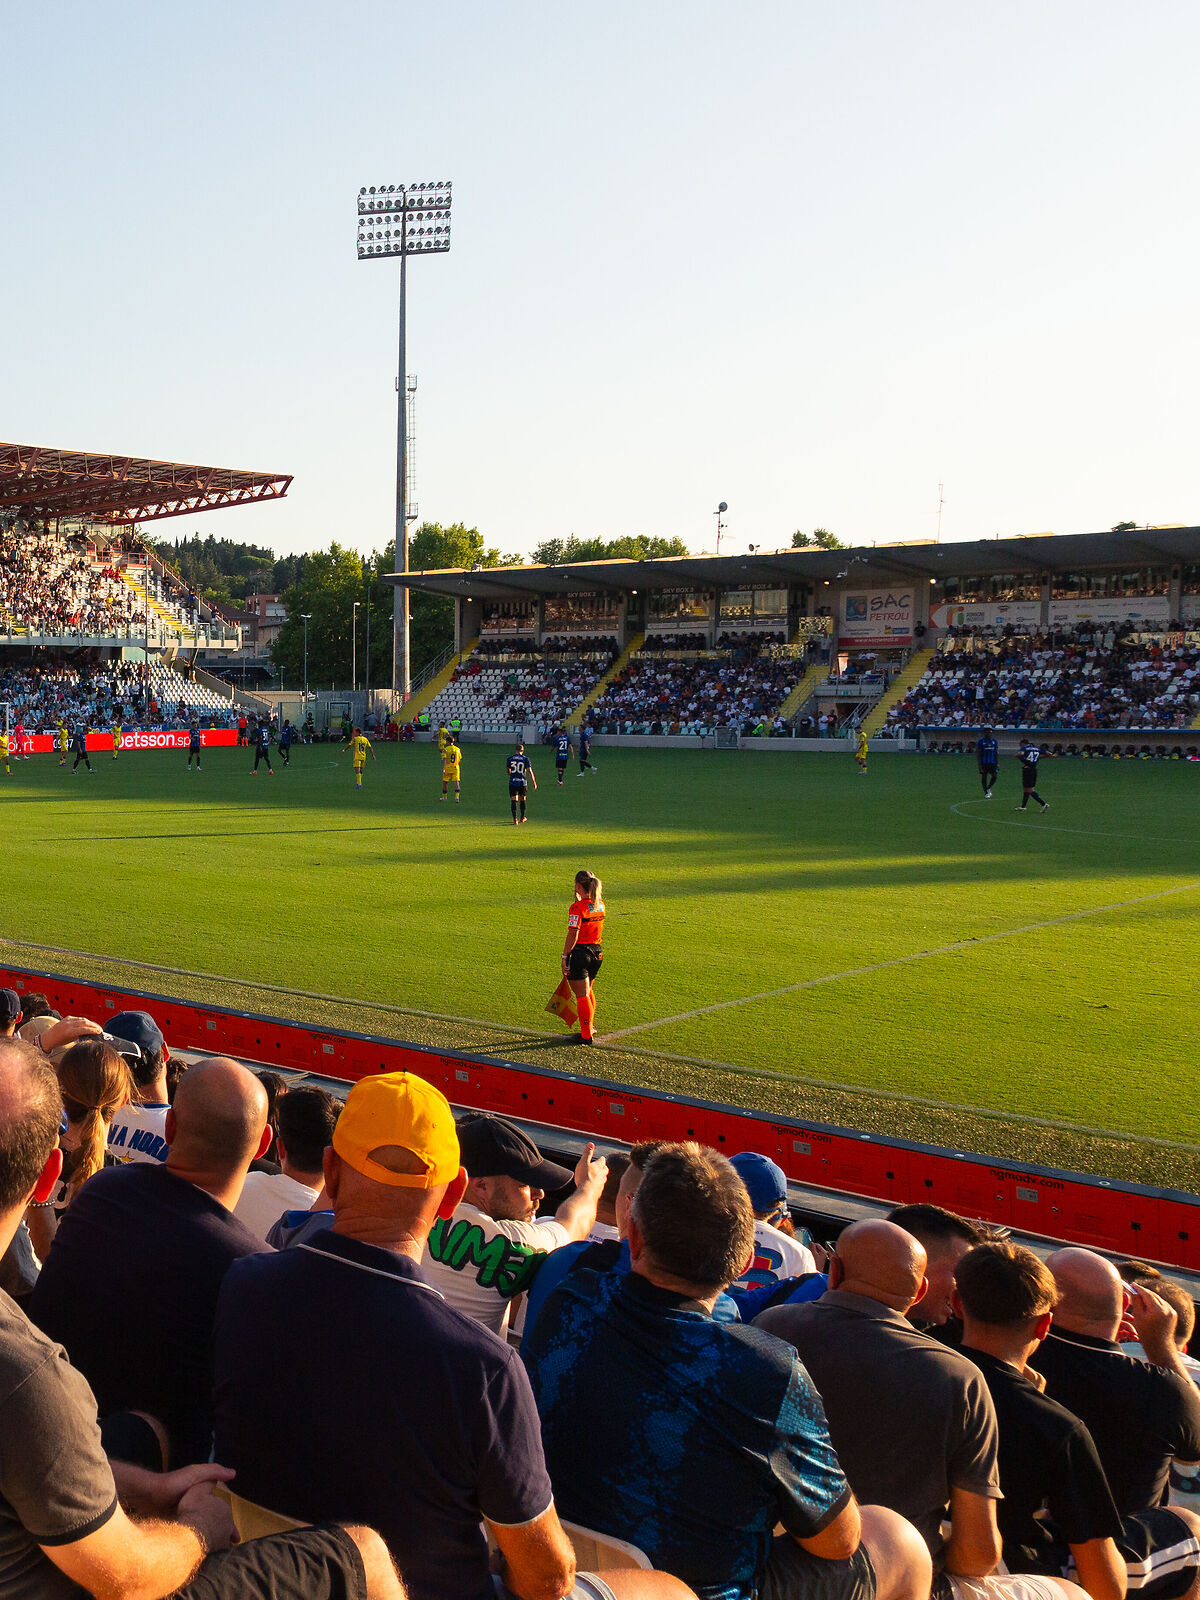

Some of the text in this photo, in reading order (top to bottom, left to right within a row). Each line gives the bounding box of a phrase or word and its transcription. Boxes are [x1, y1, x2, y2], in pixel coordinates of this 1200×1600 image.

[870, 593, 911, 611] SAC
[559, 741, 568, 750] 21
[450, 753, 456, 763] 9
[1026, 751, 1040, 762] 47
[510, 761, 525, 773] 30
[440, 1057, 483, 1071] ngmadv.com
[592, 1088, 642, 1104] ngmadv.com
[771, 1125, 832, 1143] ngmadv.com
[990, 1169, 1064, 1190] ngmadv.com
